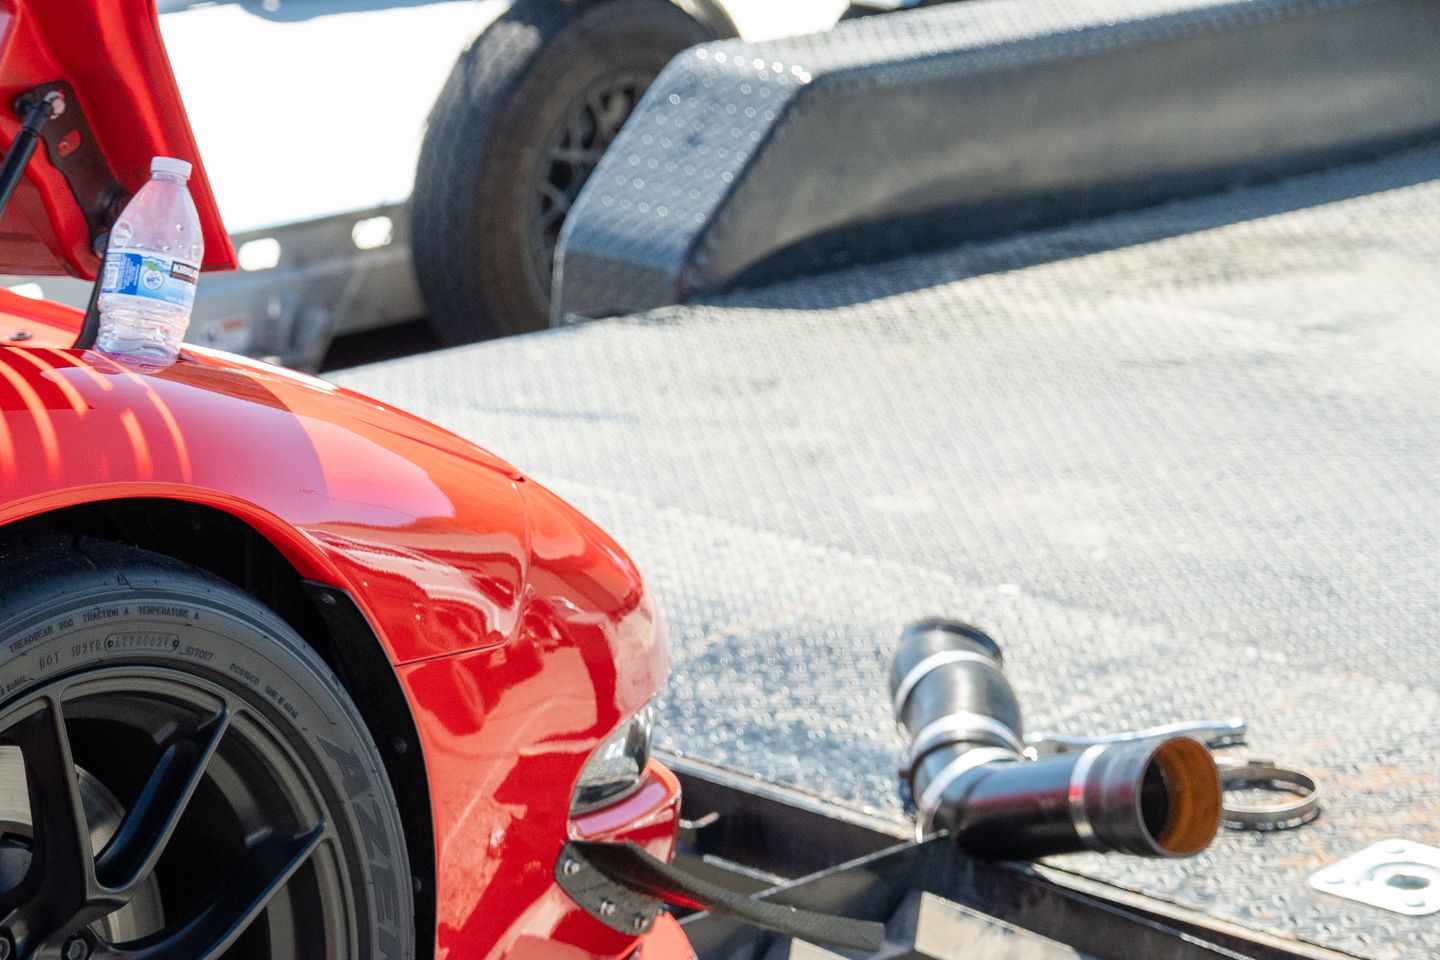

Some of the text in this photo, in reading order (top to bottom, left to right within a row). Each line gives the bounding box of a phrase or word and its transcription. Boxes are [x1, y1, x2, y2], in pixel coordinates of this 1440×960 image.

[8, 623, 53, 655] TREADWEAR
[82, 606, 119, 624] TRACTION
[38, 649, 60, 671] DOT
